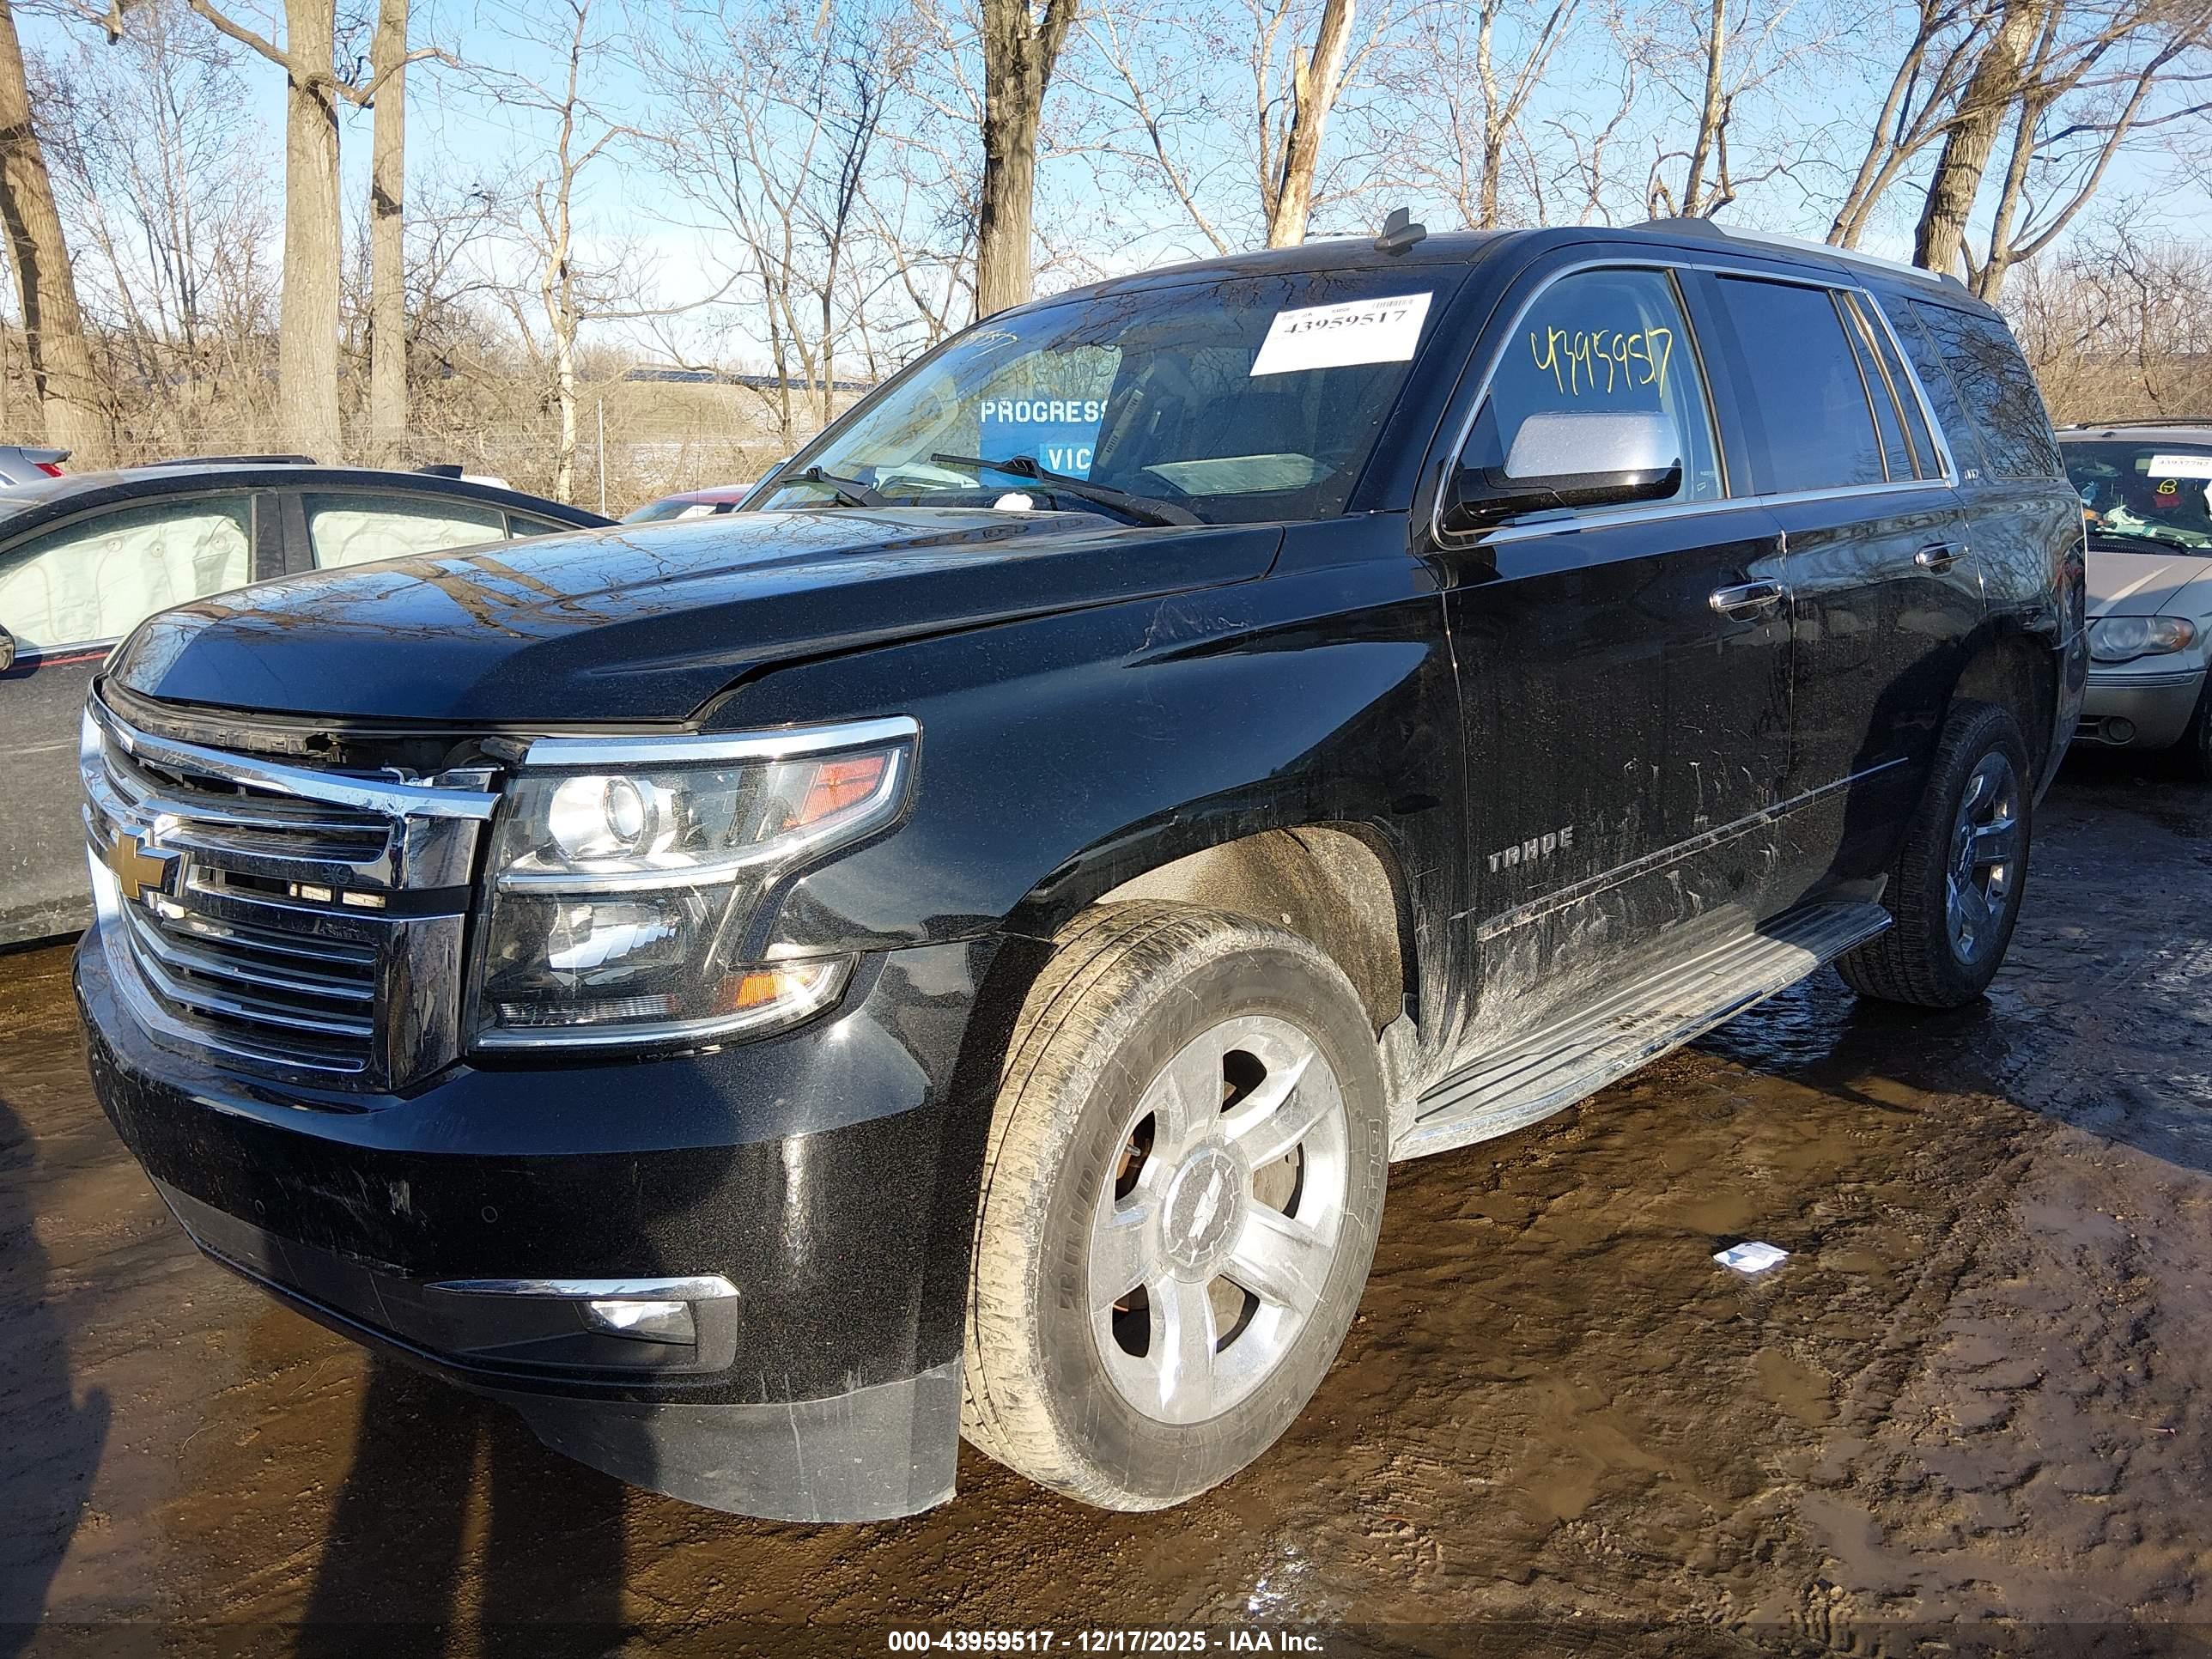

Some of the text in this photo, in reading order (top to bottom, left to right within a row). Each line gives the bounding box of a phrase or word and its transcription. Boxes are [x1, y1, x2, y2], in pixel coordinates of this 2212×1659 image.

[1284, 309, 1408, 334] 43959517
[1530, 325, 1674, 398] 43959517
[1490, 825, 1573, 873] TAHOE
